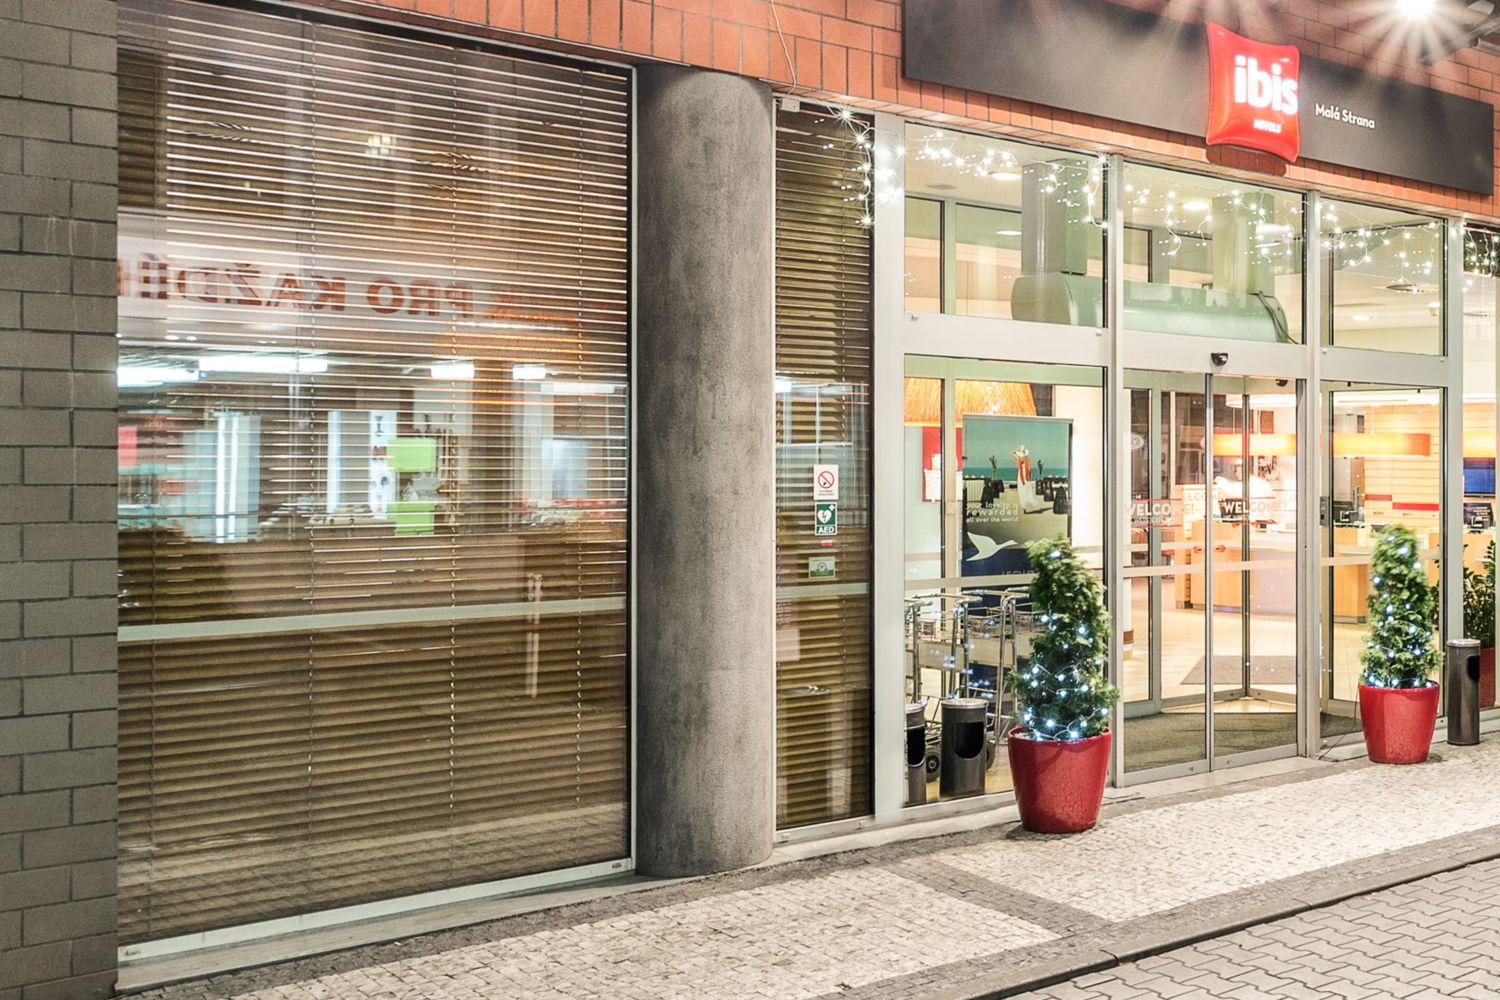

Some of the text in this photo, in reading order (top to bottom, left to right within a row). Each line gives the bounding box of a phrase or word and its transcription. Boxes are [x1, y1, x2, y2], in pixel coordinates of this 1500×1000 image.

[1234, 55, 1298, 116] ibis
[1253, 118, 1282, 134] HOTELS
[1315, 103, 1375, 129] Malá Strana
[818, 526, 834, 534] AED
